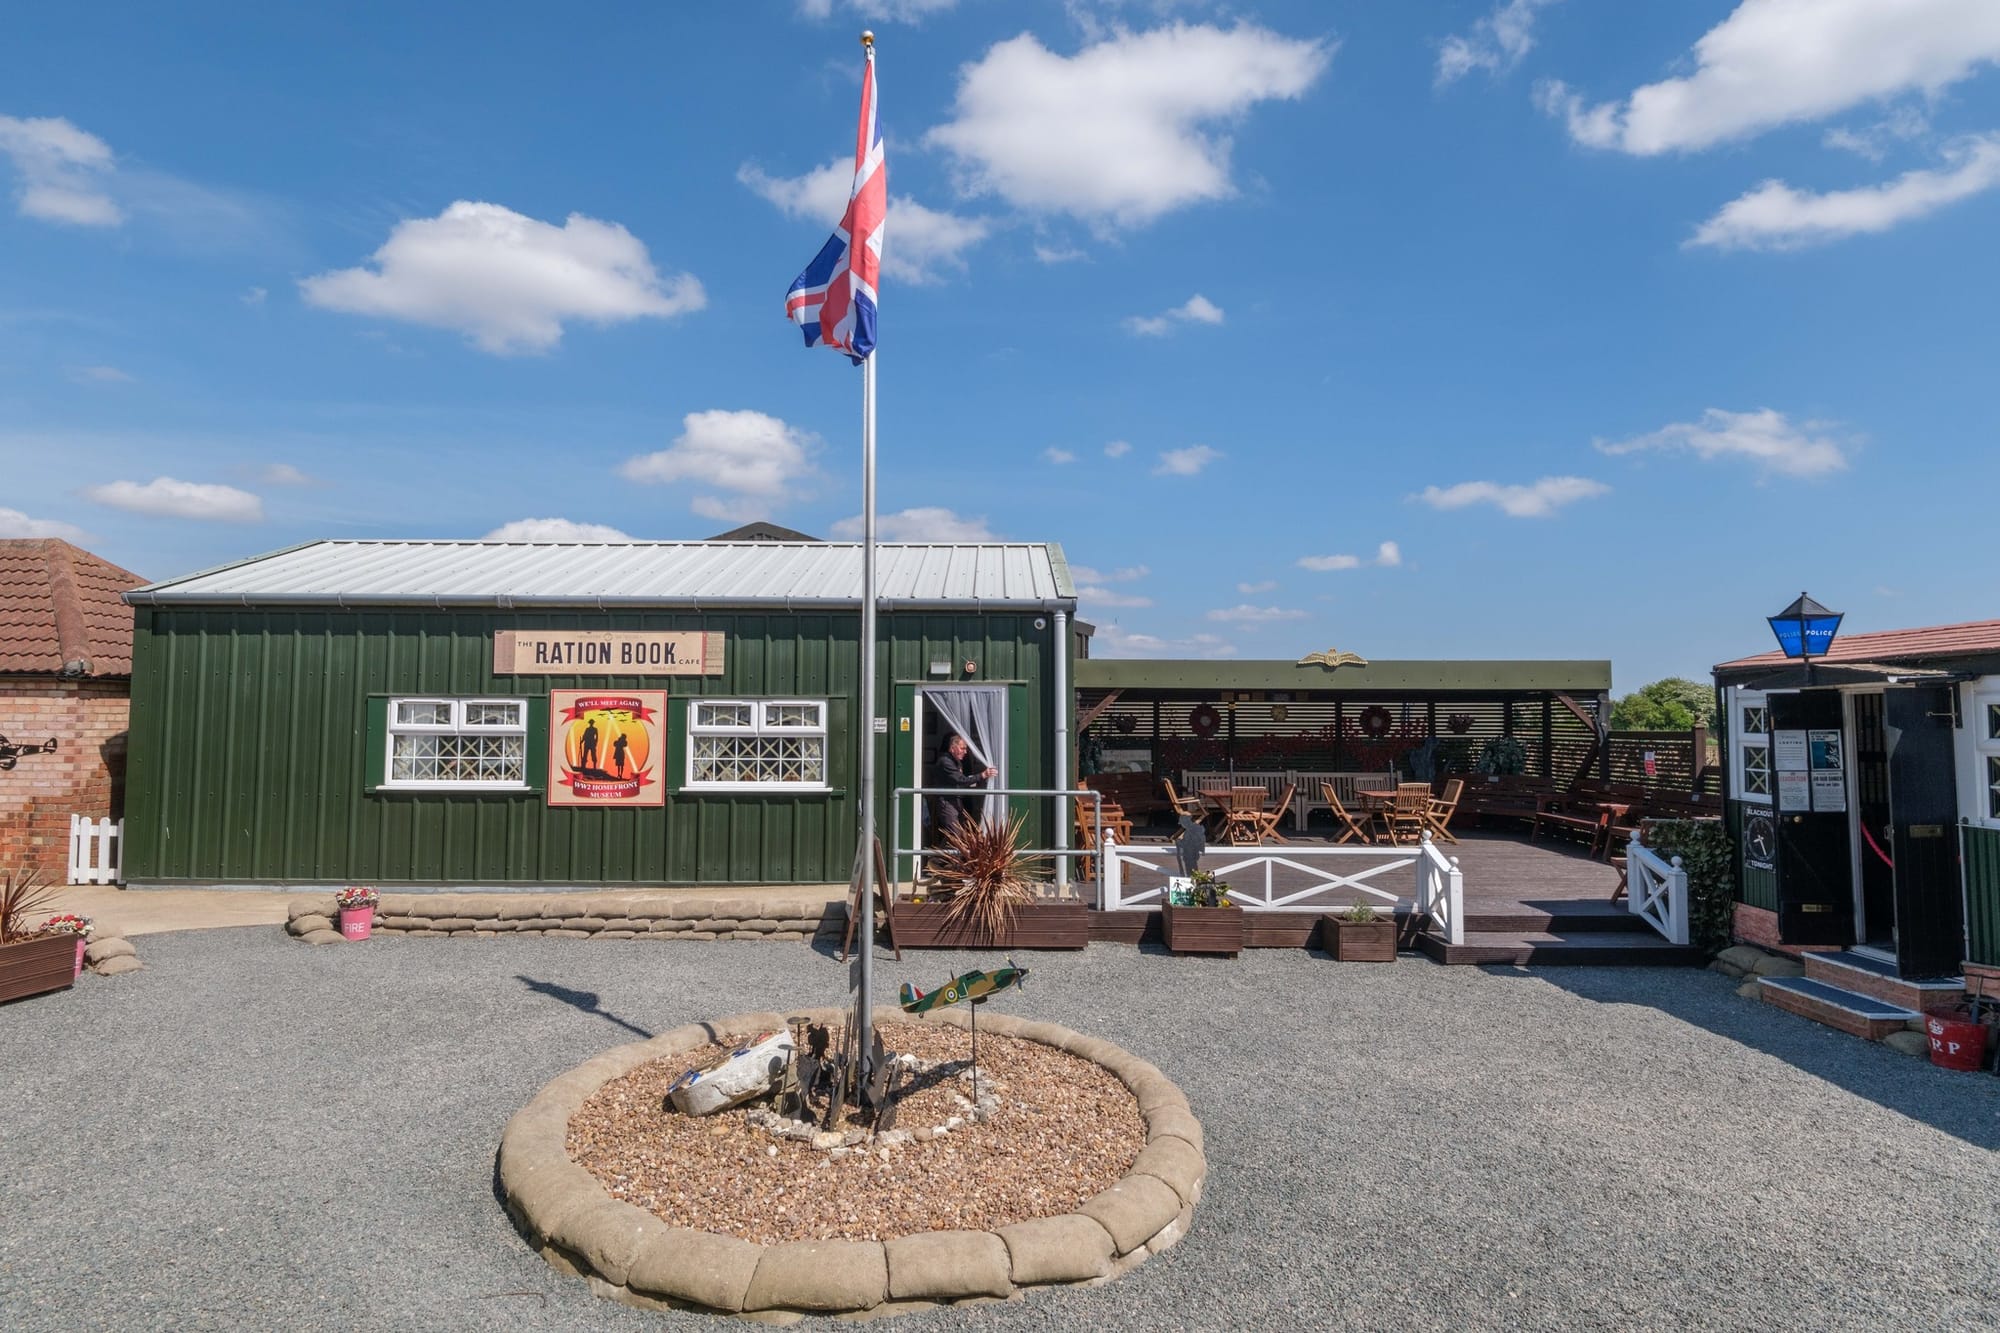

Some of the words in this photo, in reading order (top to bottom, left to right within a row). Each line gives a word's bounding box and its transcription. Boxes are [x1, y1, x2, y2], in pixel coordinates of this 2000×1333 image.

[535, 641, 612, 664] RATION
[621, 642, 676, 665] BOOK
[574, 781, 591, 790] WW2
[592, 781, 639, 791] HOMEFRONT
[1746, 807, 1774, 818] BLACKOUT
[344, 922, 366, 933] FIRE
